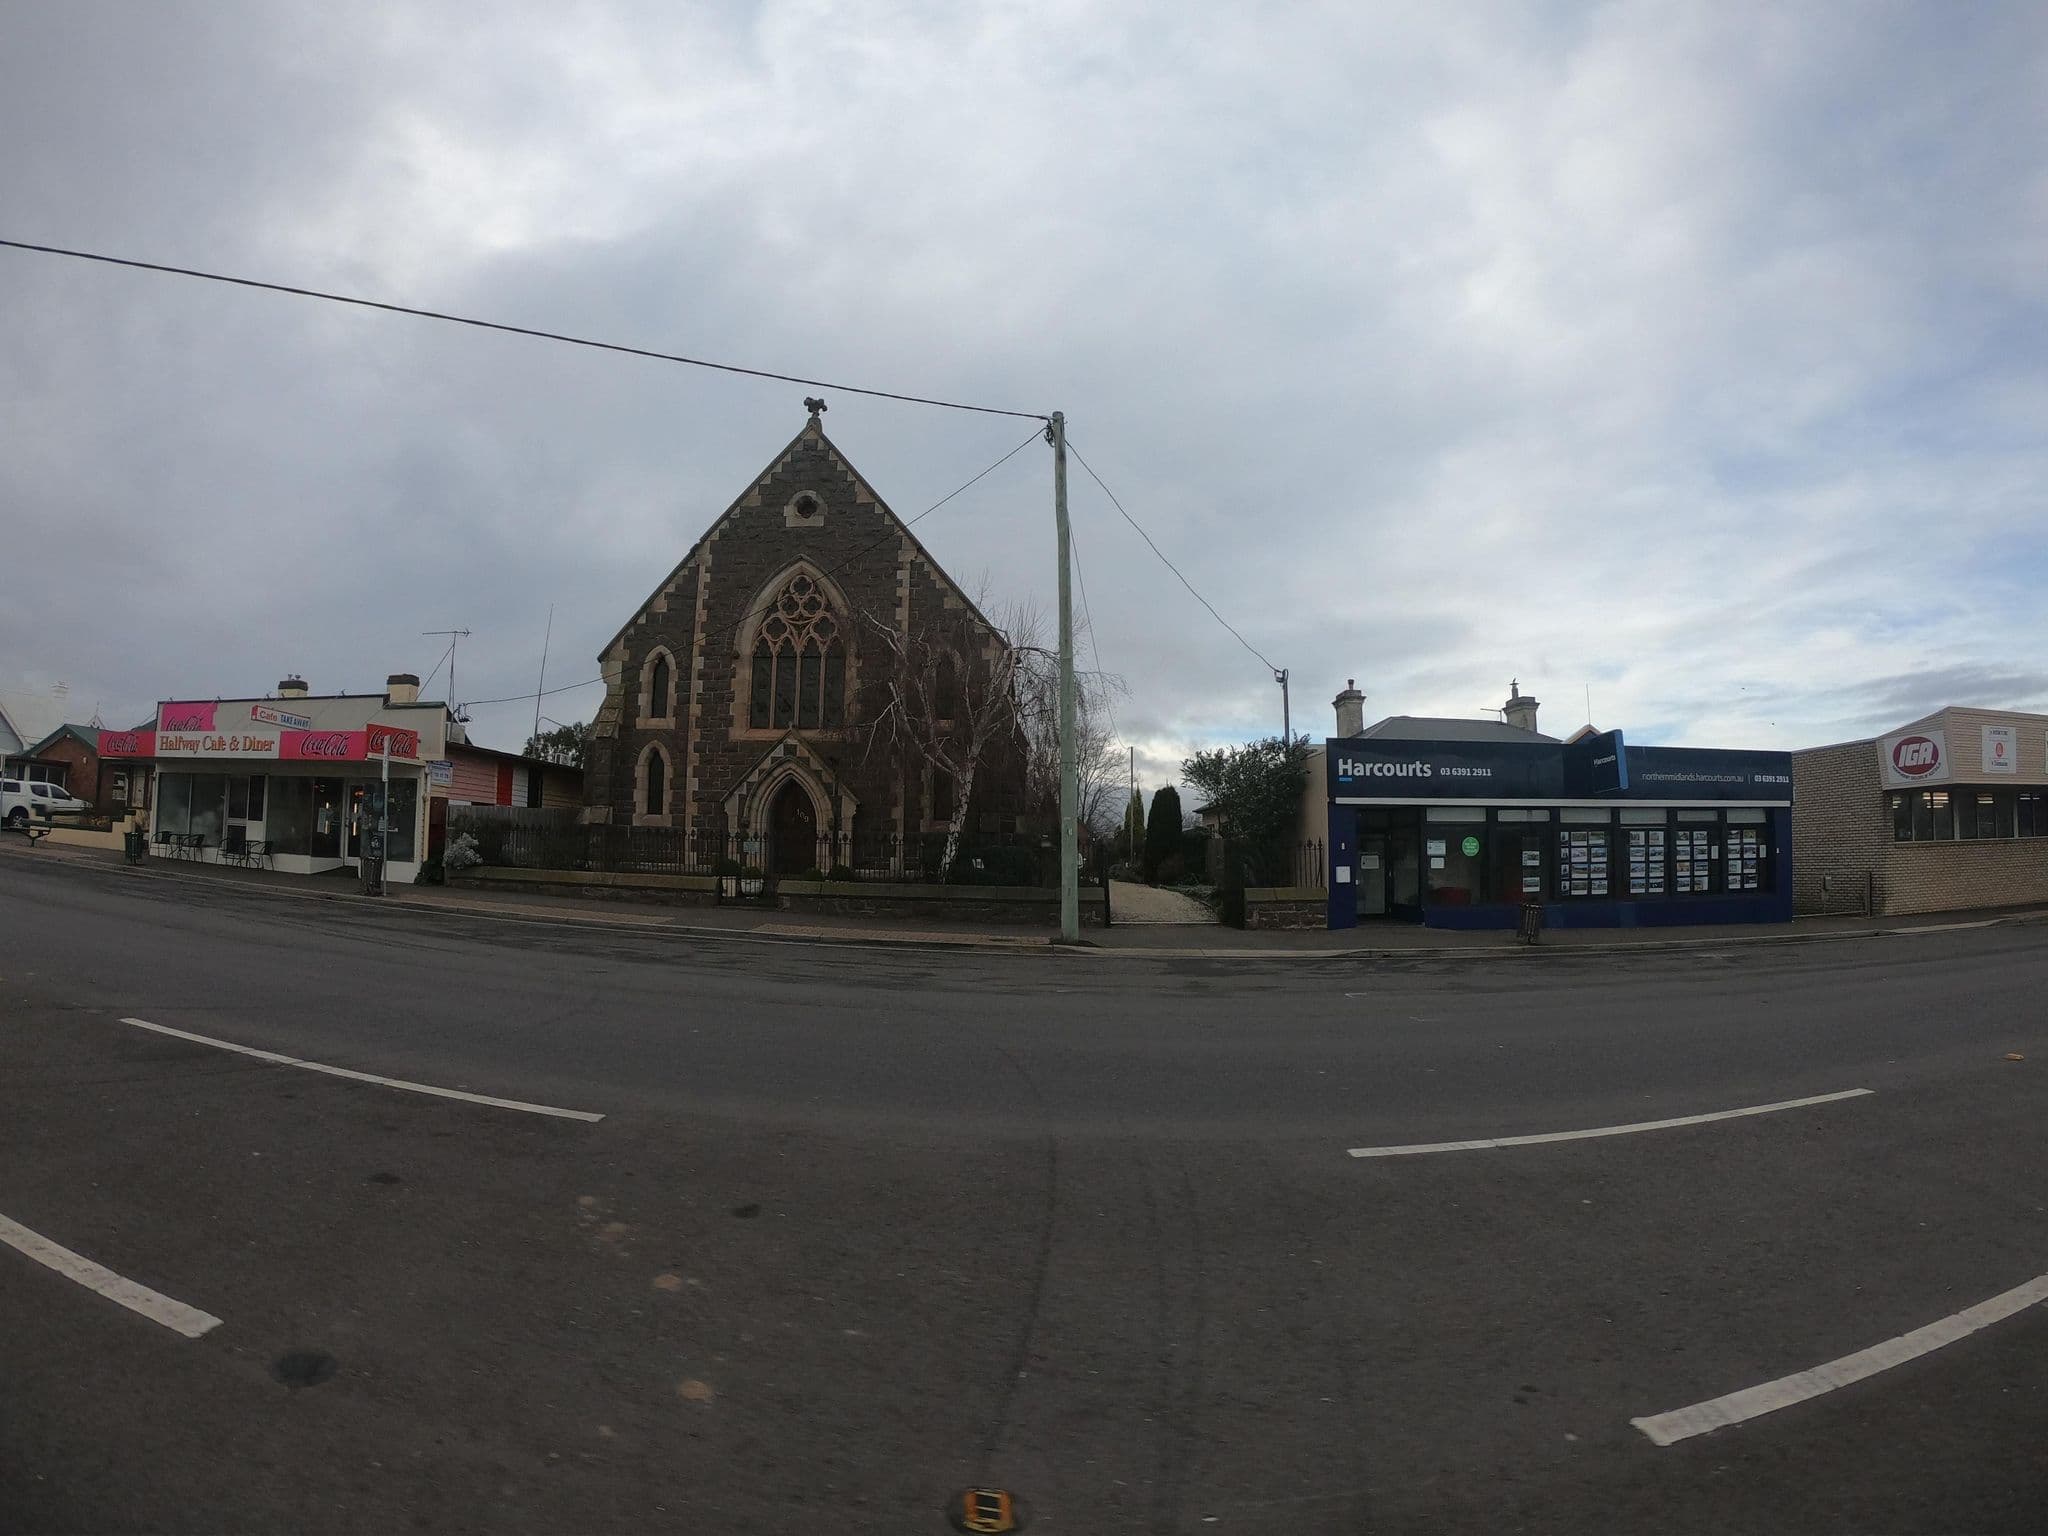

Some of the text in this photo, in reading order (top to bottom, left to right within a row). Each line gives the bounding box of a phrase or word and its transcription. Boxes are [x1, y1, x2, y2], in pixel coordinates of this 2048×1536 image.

[260, 711, 278, 722] Cafe
[159, 736, 200, 754] Halfway
[229, 736, 240, 751] &
[242, 736, 275, 752] Diner
[300, 733, 349, 756] Coca-Cola
[370, 728, 411, 755] Coc-Cola
[1593, 755, 1616, 766] Harcourts
[1898, 741, 1934, 768] IGA
[1338, 758, 1492, 777] Harcourts 03 6391 2911
[1642, 772, 1744, 783] northernmidlands.harcourts.com.au
